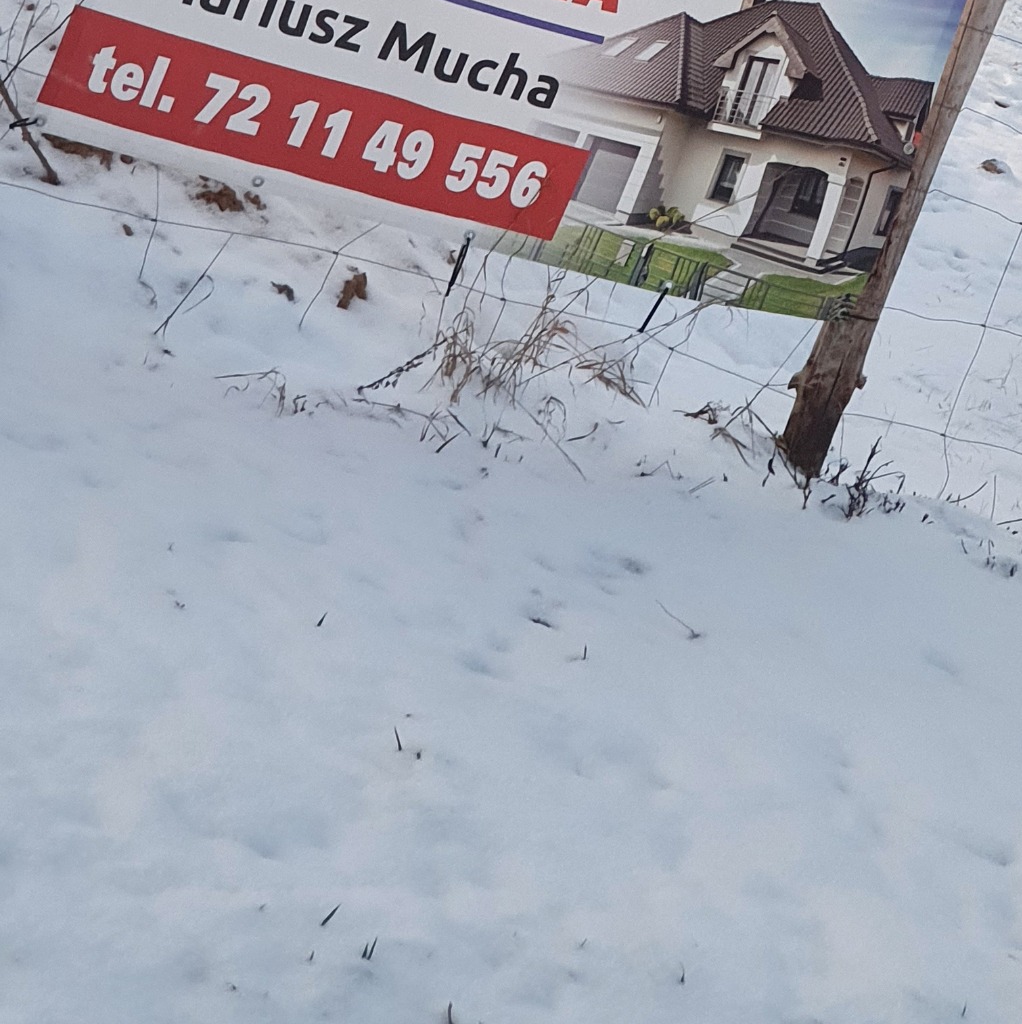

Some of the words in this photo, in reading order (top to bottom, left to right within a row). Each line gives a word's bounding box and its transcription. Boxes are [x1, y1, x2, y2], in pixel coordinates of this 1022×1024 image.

[87, 45, 176, 113] tel.
[193, 72, 271, 136] 72
[286, 100, 353, 160] 11
[362, 120, 435, 181] 49
[445, 143, 548, 209] 556
[377, 21, 560, 109] Mucha
